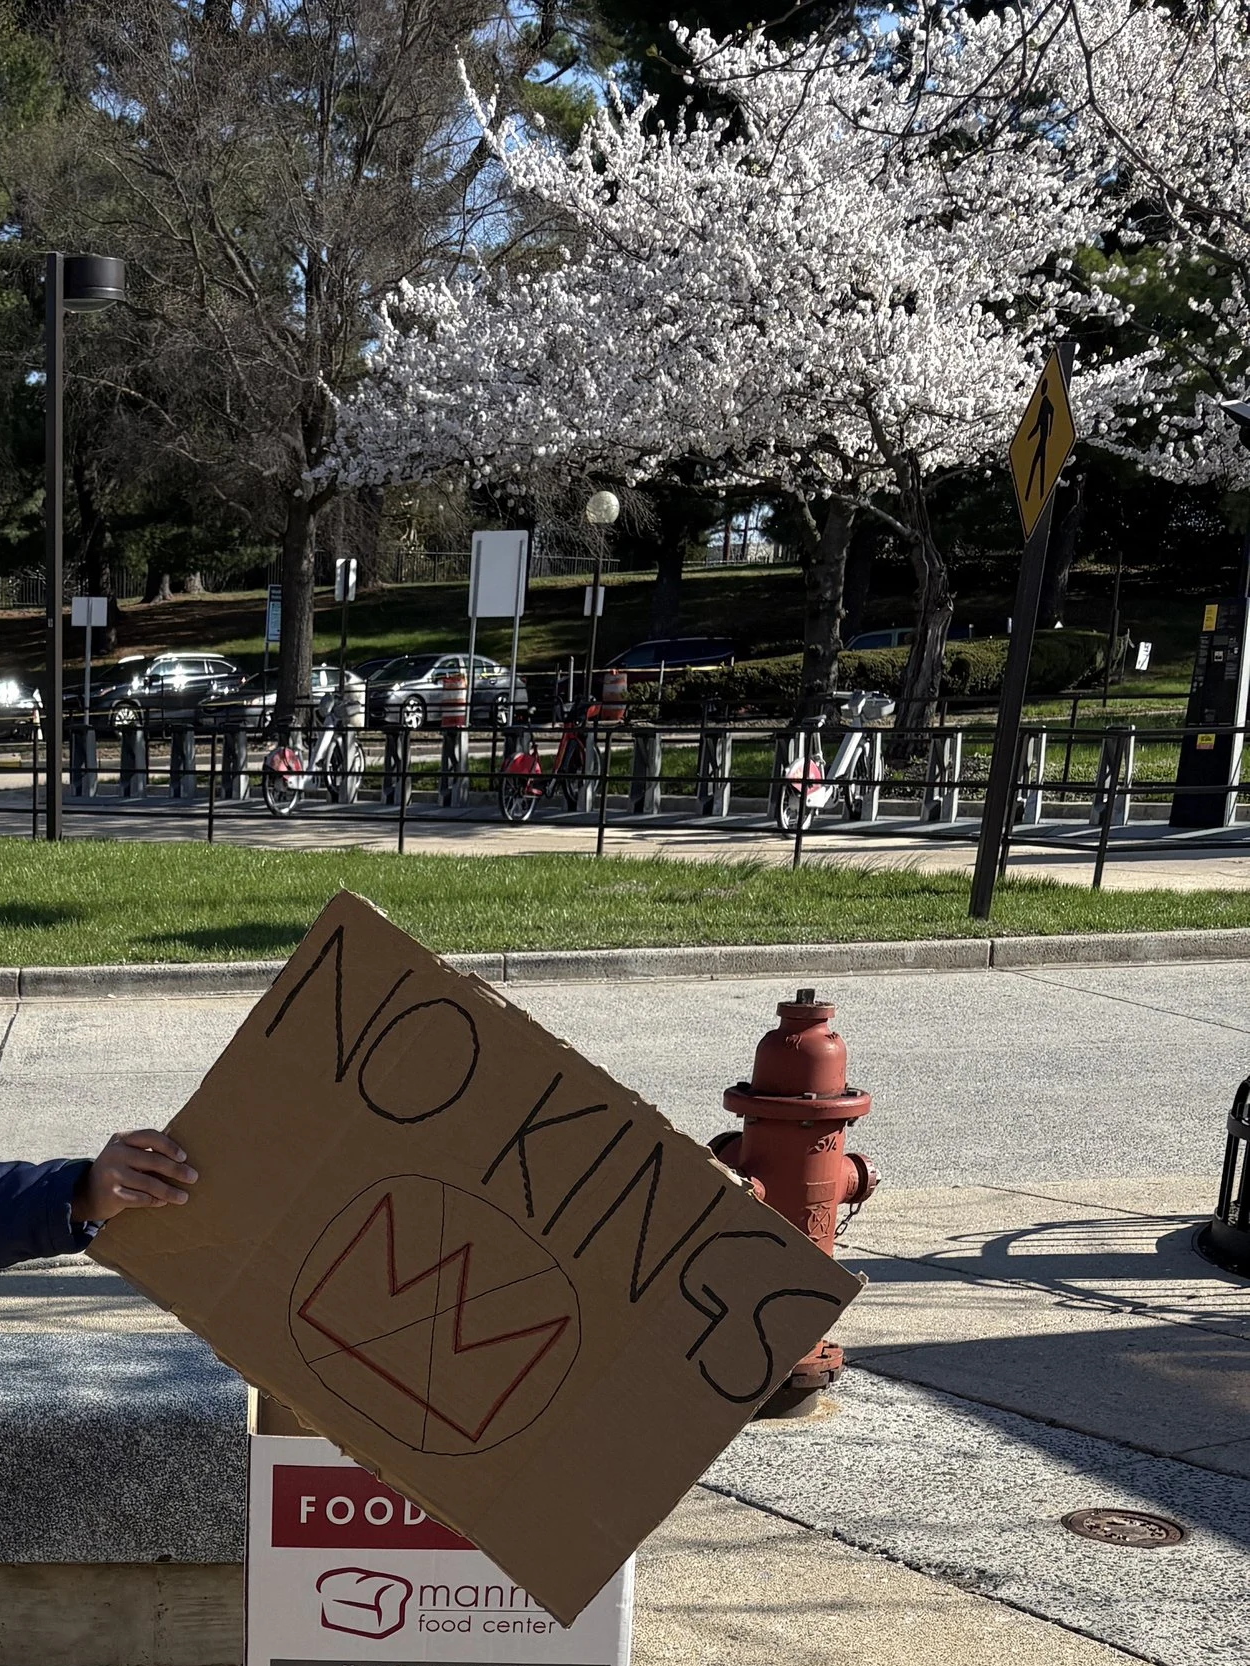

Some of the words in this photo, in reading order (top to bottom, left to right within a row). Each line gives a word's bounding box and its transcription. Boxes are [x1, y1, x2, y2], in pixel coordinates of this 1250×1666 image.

[265, 924, 481, 1125] NO
[480, 1072, 842, 1404] KINGS
[300, 1496, 428, 1525] FOOD
[419, 1585, 544, 1608] mann
[418, 1614, 472, 1633] food
[482, 1617, 556, 1634] center
